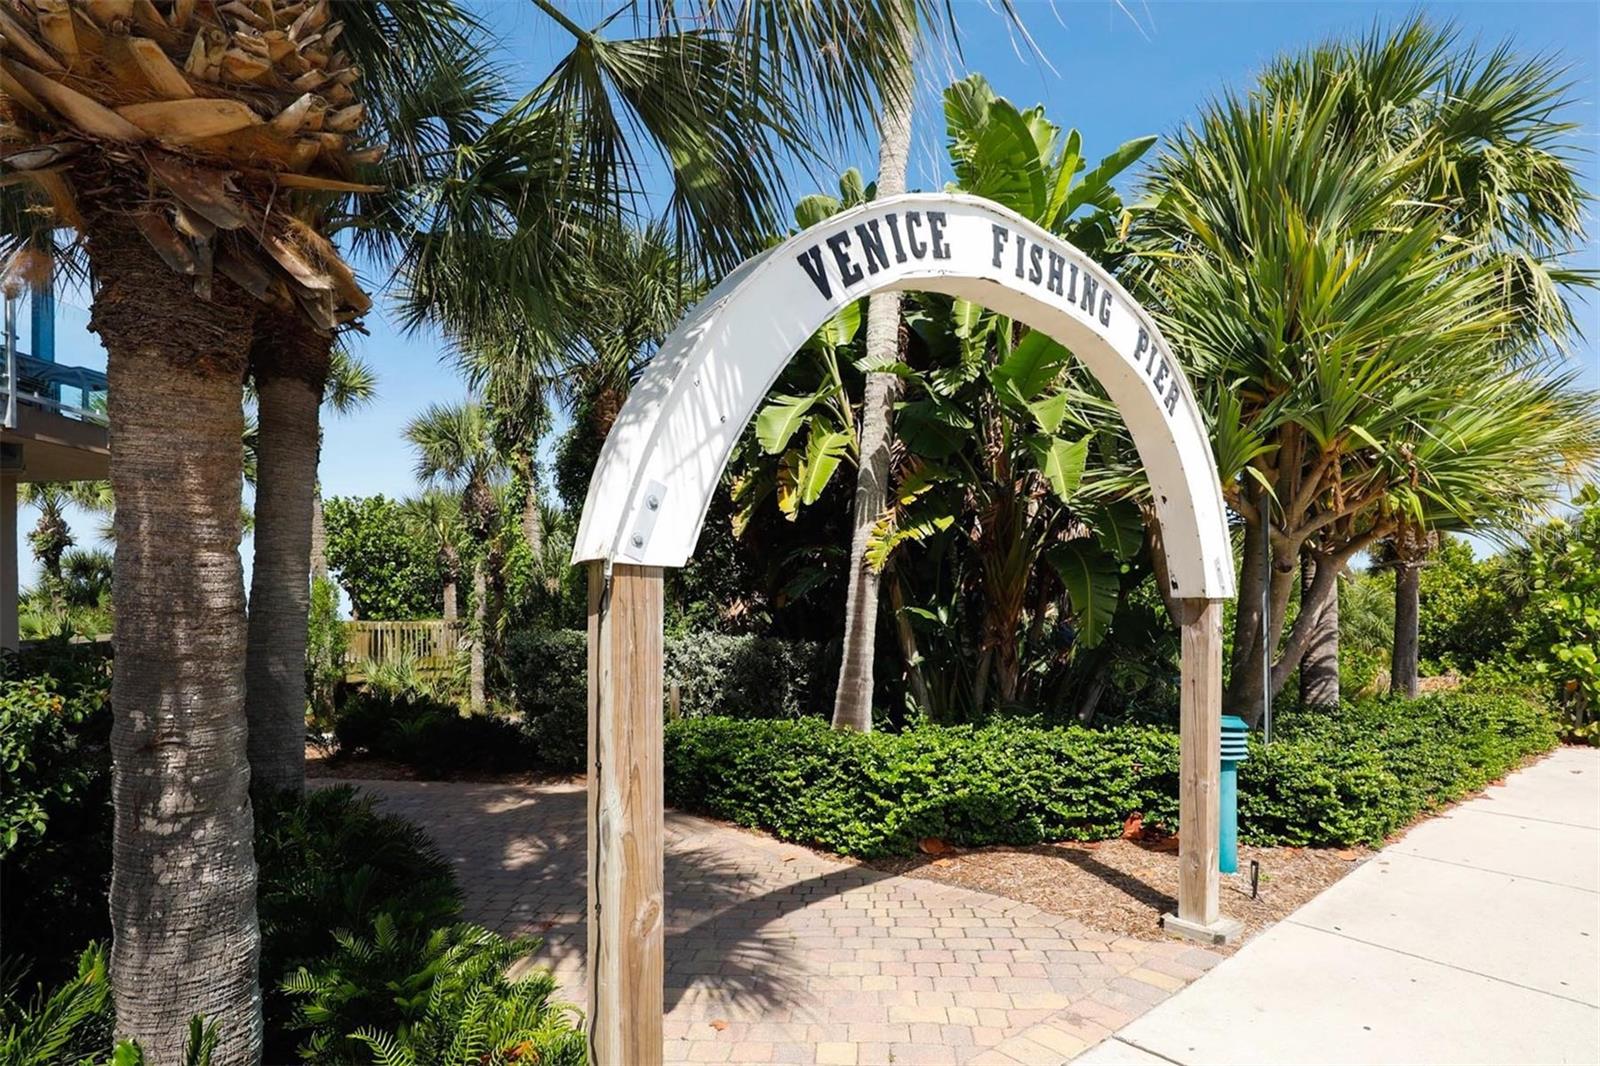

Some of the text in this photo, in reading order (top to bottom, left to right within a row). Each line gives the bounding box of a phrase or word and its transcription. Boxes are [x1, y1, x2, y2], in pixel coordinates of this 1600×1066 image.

[796, 210, 1181, 417] VENICE FISHING PIER
